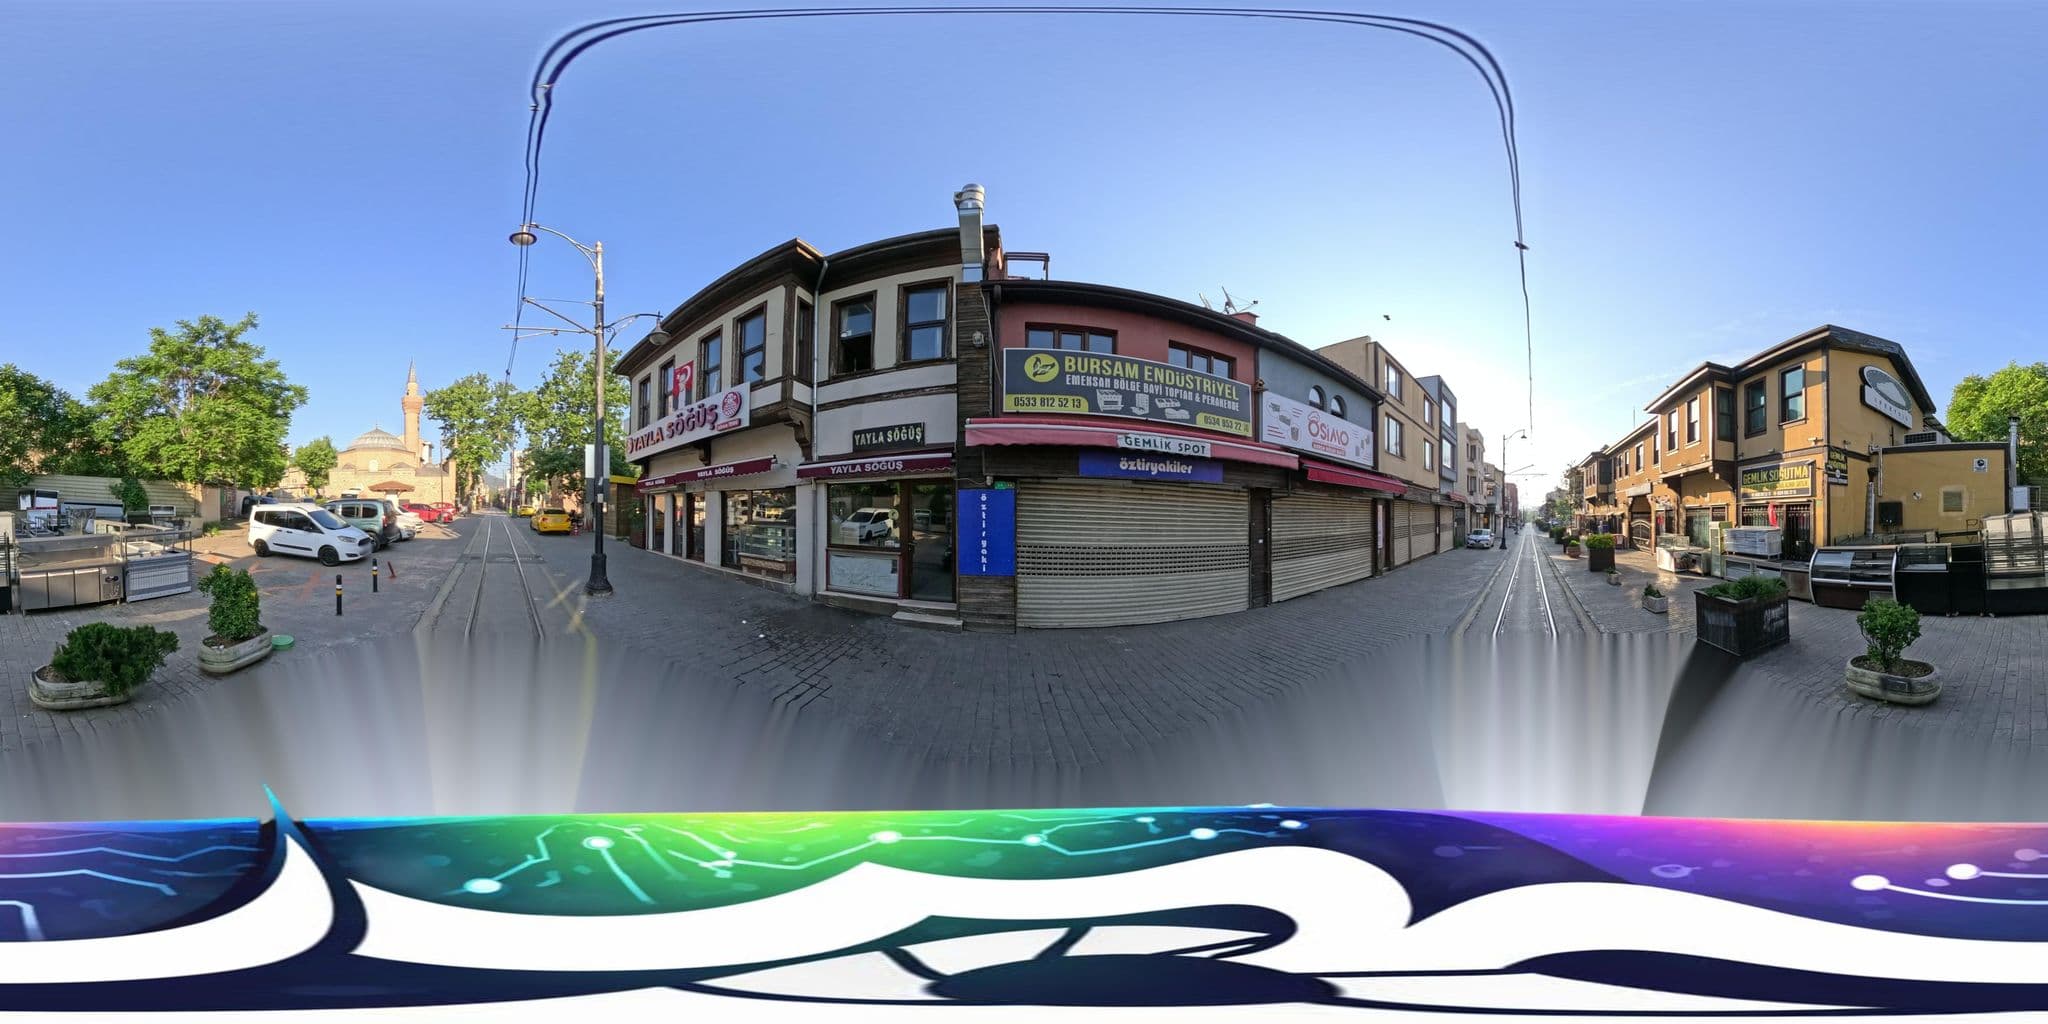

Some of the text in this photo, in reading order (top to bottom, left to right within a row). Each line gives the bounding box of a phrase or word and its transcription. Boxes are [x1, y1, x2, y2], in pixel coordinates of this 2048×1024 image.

[1064, 355, 1139, 379] BURSAM
[1113, 377, 1140, 392] BÖLGE
[1165, 386, 1193, 401] TOPTAN
[1195, 394, 1201, 403] &
[1014, 396, 1037, 407] 0533
[1058, 398, 1069, 408] 52
[1072, 398, 1081, 408] 13
[632, 402, 718, 452] YAYLA SÖĞÜŞ
[1234, 422, 1242, 431] 22
[854, 426, 922, 446] YAYLA SÖĞÜŞ
[1124, 436, 1206, 455] GEMLİK SPOT
[830, 464, 862, 475] YAYLA
[1119, 457, 1193, 475] öztiryakiler
[1743, 470, 1768, 485] GEMLİK
